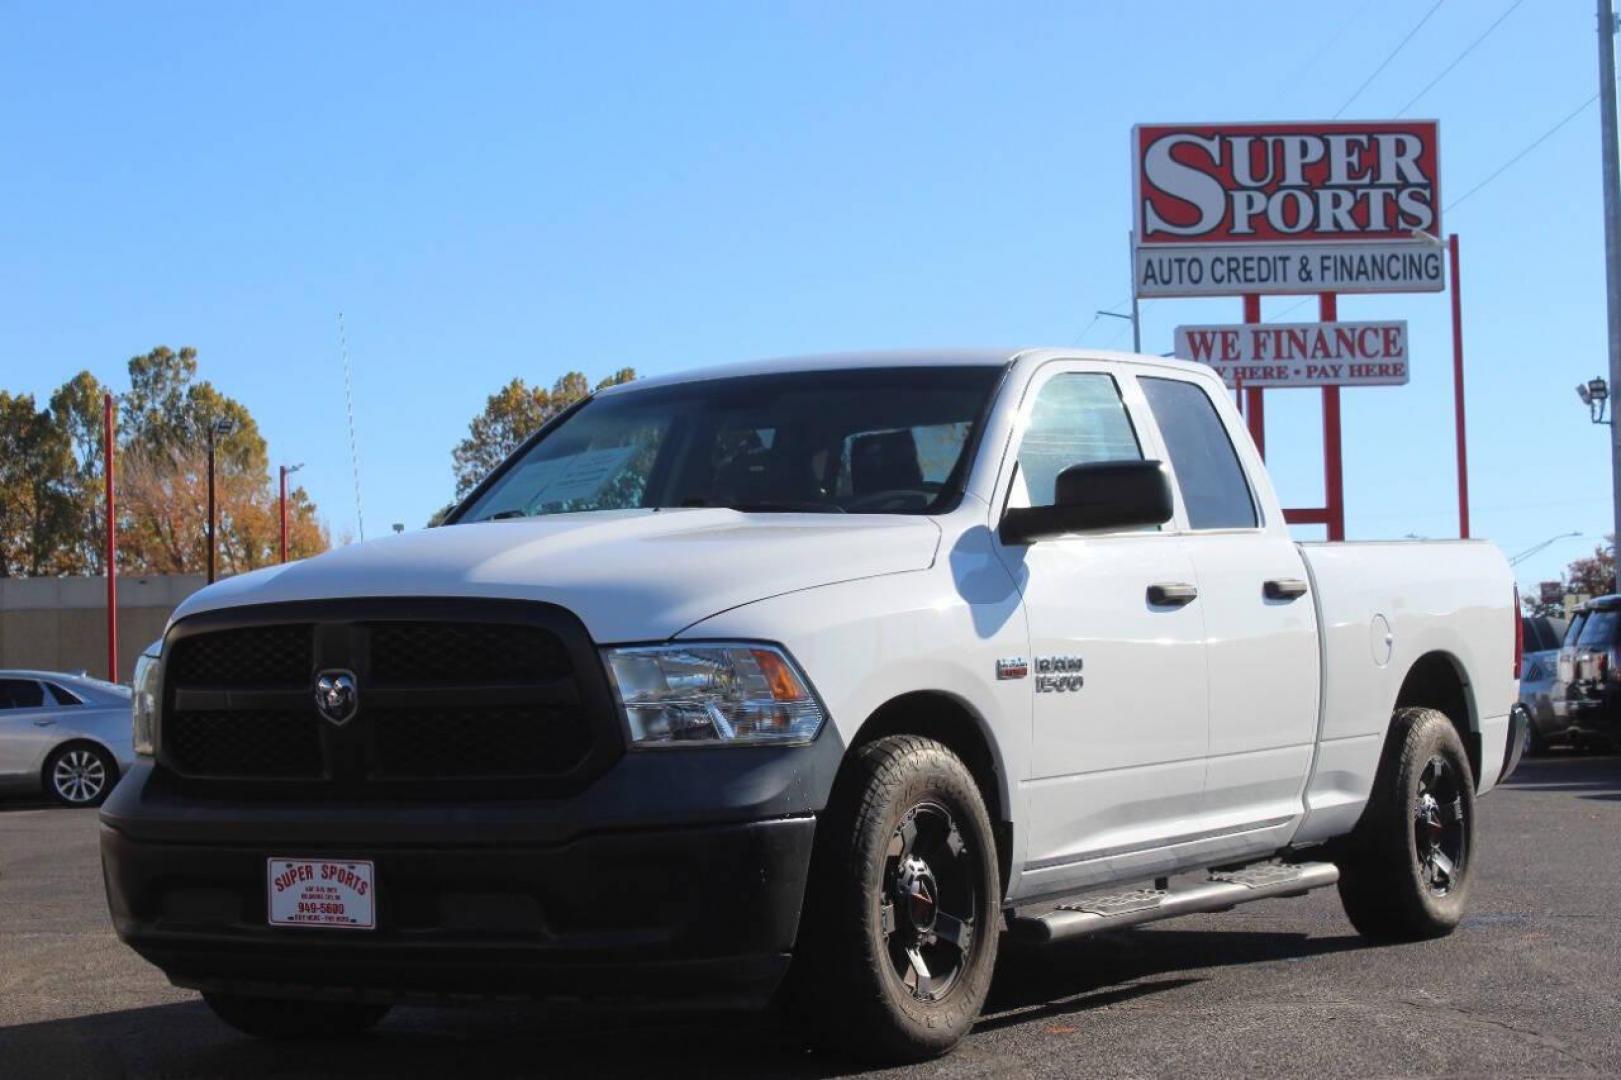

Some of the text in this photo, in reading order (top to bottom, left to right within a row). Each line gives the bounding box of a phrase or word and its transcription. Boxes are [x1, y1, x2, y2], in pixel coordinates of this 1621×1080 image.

[1144, 132, 1430, 236] SUPER
[1143, 252, 1440, 286] AUTO CREDIT & FINANCING
[1186, 326, 1403, 362] WE FINANCE
[1233, 364, 1289, 380] HERE
[1306, 364, 1343, 379] PAY
[1349, 362, 1405, 378] HERE
[1034, 656, 1083, 674] RAM
[1035, 675, 1084, 694] 1500
[275, 864, 368, 896] SUPER SPORTS
